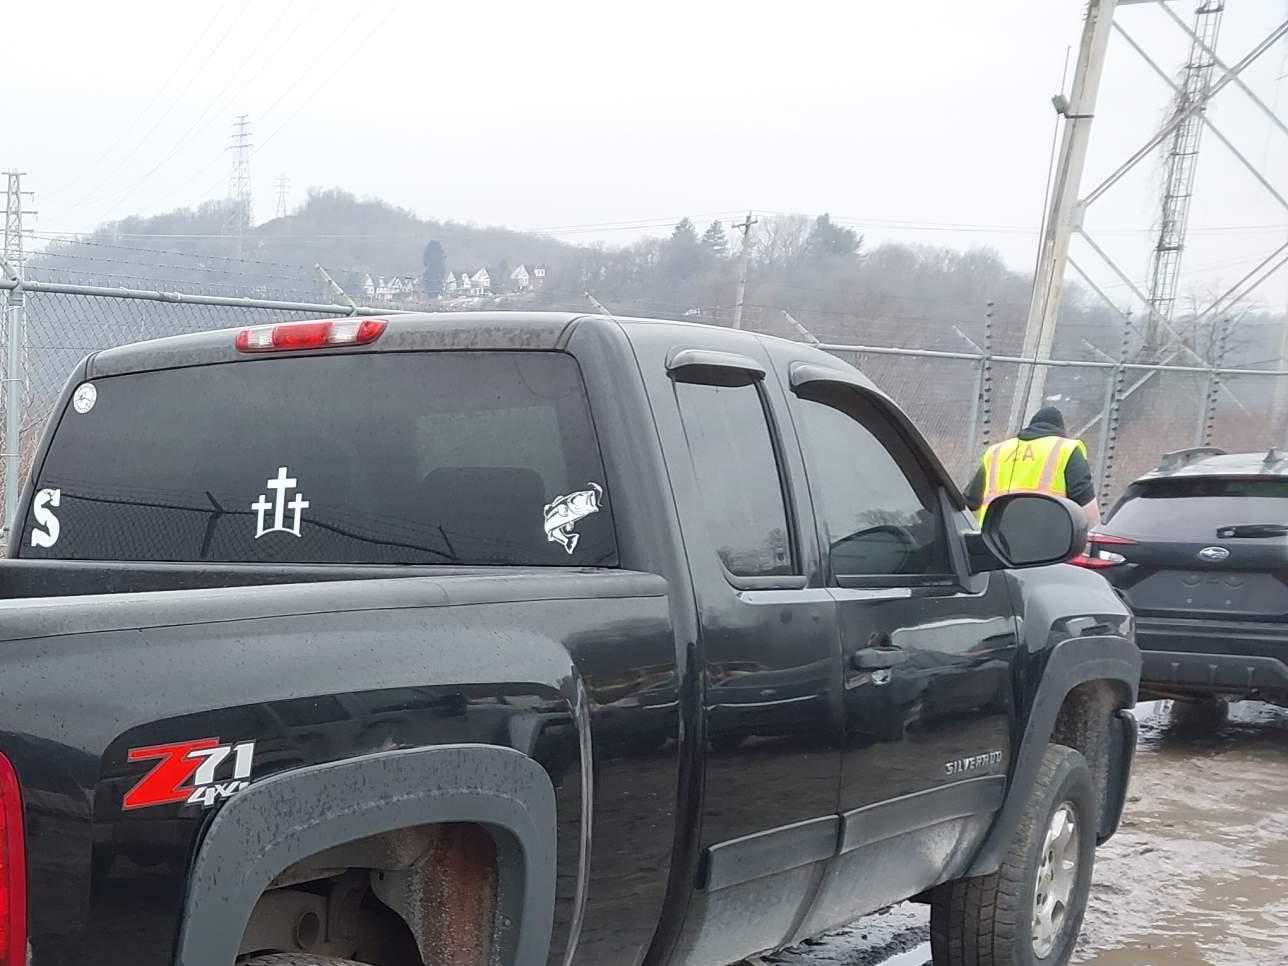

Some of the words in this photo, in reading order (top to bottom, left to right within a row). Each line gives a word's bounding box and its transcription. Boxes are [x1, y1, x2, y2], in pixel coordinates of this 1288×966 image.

[31, 488, 60, 548] S
[123, 737, 255, 810] Z71
[945, 751, 1002, 775] SILVERADO
